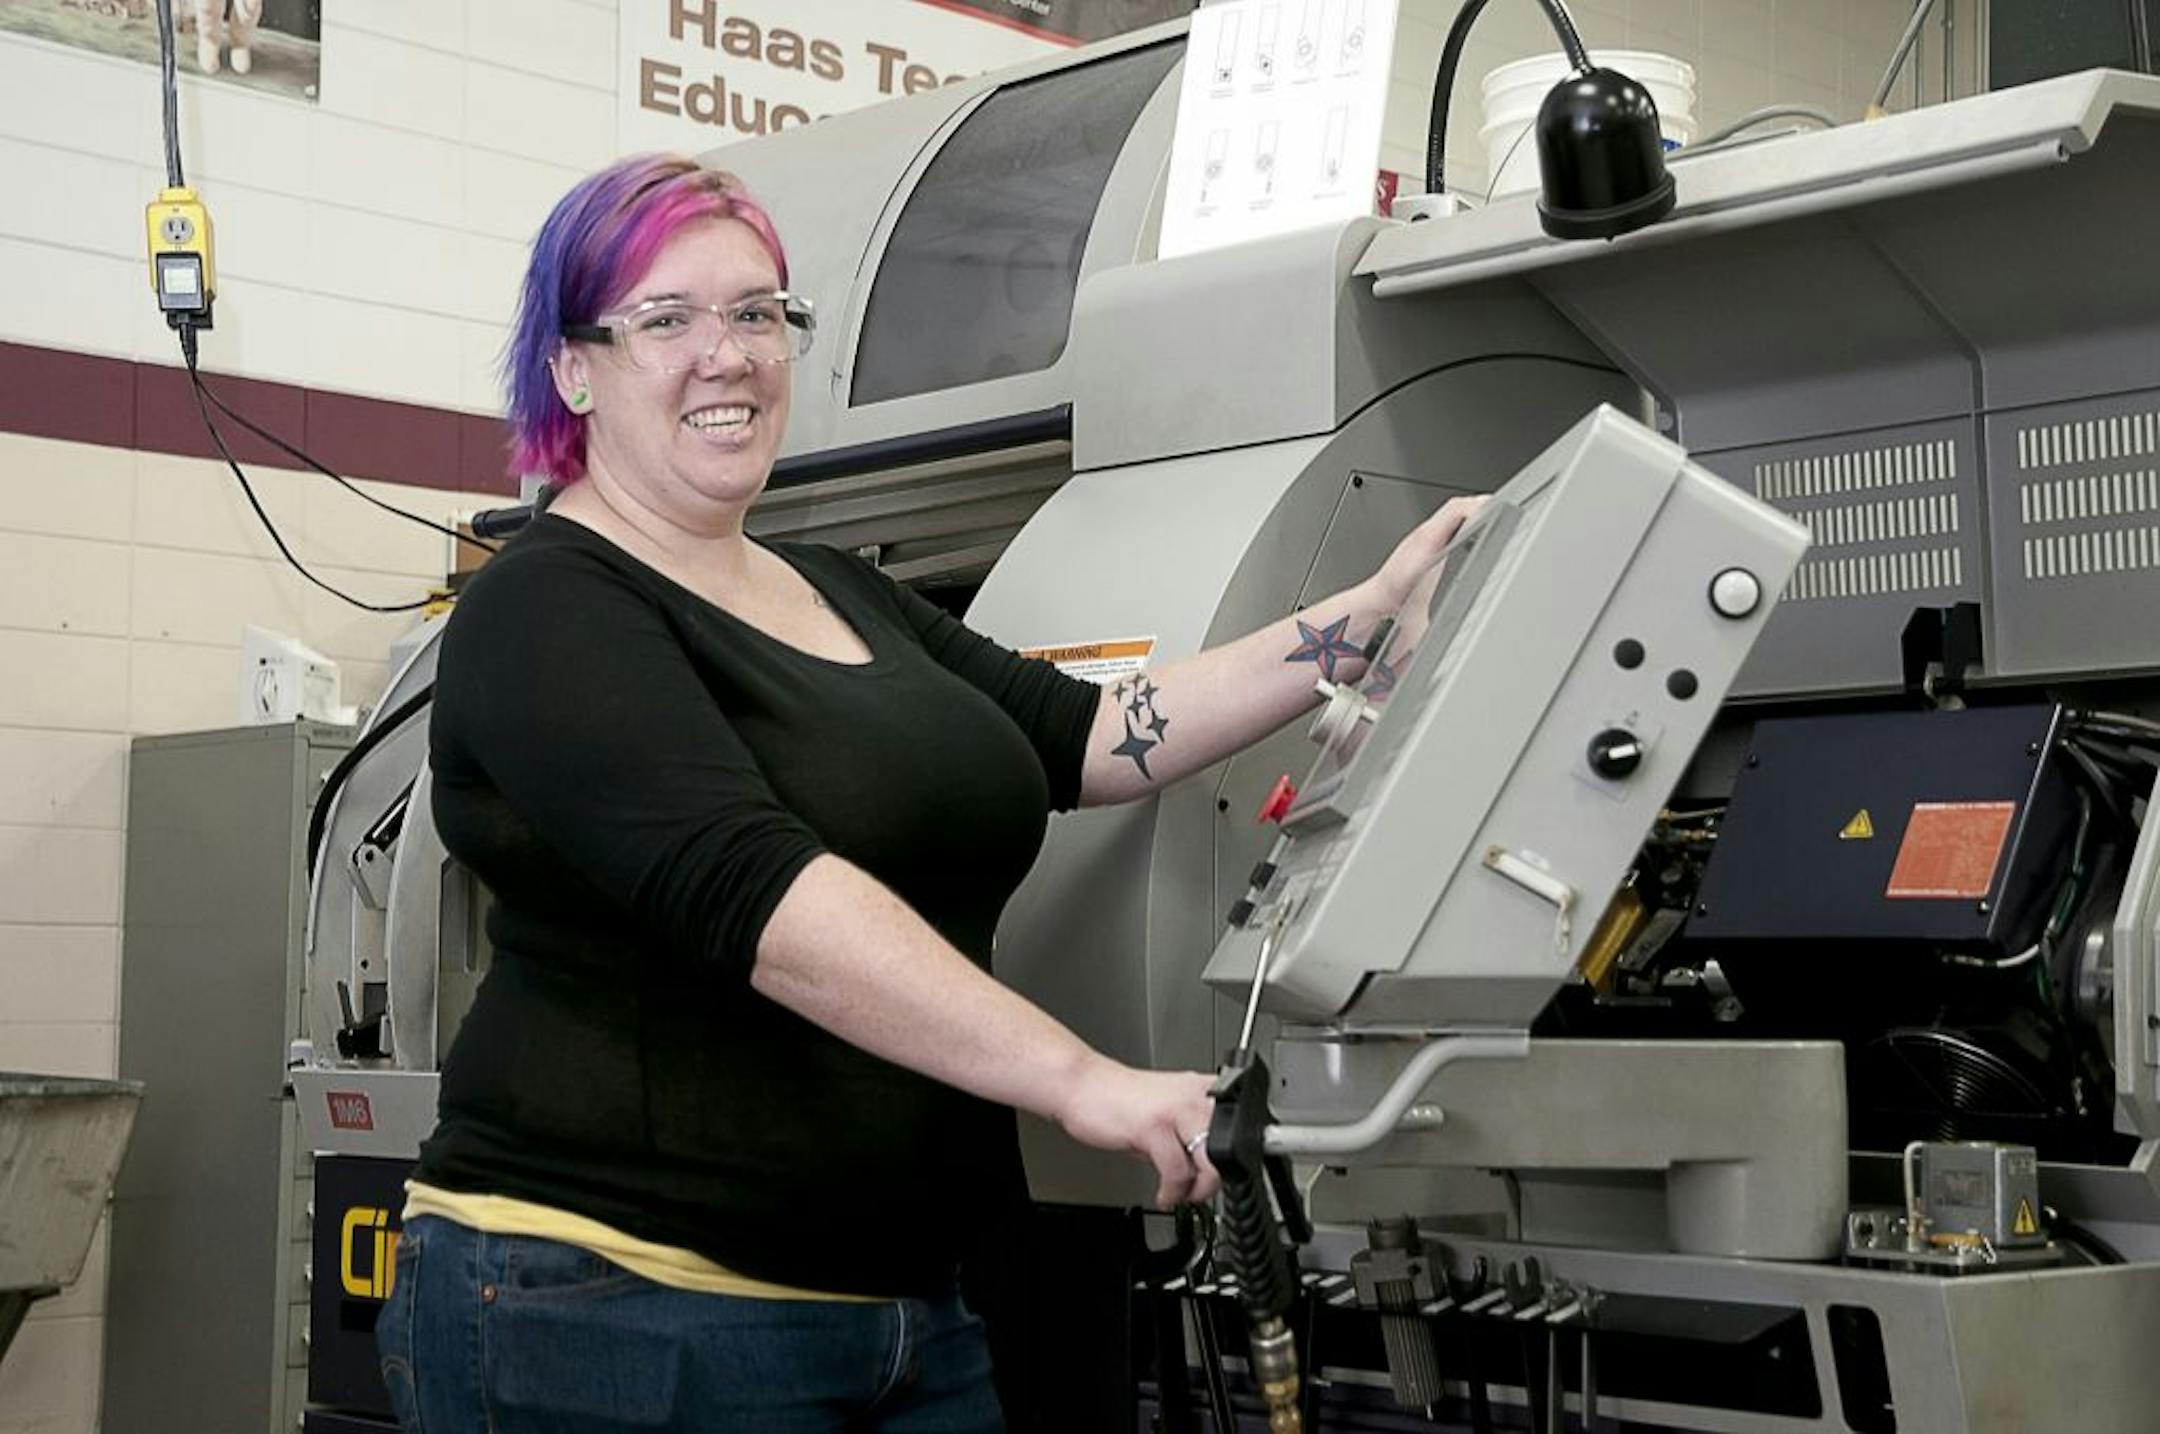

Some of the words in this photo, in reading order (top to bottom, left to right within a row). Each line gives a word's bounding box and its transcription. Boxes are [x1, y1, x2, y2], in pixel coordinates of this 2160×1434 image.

[669, 0, 844, 82] Haas
[866, 41, 966, 96] Te
[640, 57, 833, 136] Educ
[341, 1206, 404, 1299] Ci
